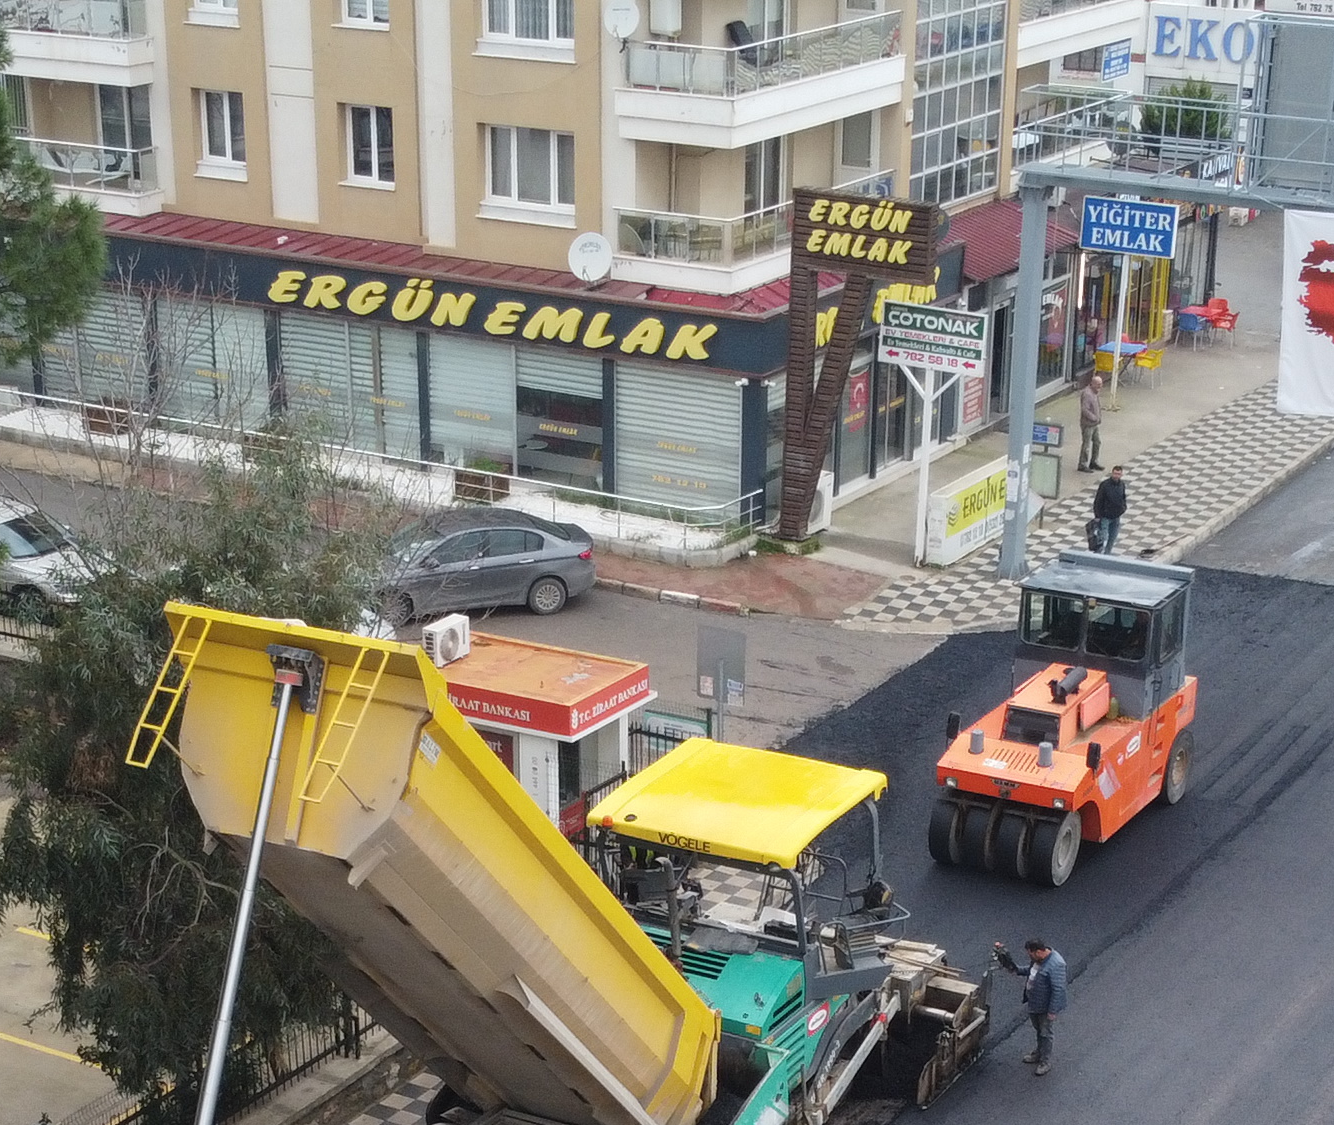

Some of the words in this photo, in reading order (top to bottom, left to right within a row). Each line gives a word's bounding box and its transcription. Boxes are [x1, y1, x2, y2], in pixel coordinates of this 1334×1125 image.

[808, 199, 913, 233] ERGÜN
[1088, 203, 1171, 231] YİĞİTER
[806, 229, 912, 264] EMLAK
[1091, 227, 1164, 252] EMLAK
[267, 270, 476, 327] ERGÜN
[484, 301, 717, 360] EMLAK
[888, 310, 980, 336] ÇOTONAK
[885, 329, 897, 337] EV
[957, 339, 981, 349] CAFE
[903, 351, 925, 363] 782
[928, 355, 944, 366] 58
[947, 358, 959, 368] 18
[482, 702, 531, 722] BANKASI
[578, 709, 592, 725] T.C.
[592, 694, 618, 717] ZİRAAT
[617, 678, 648, 704] BANKASI
[658, 831, 711, 853] VÖGELE
